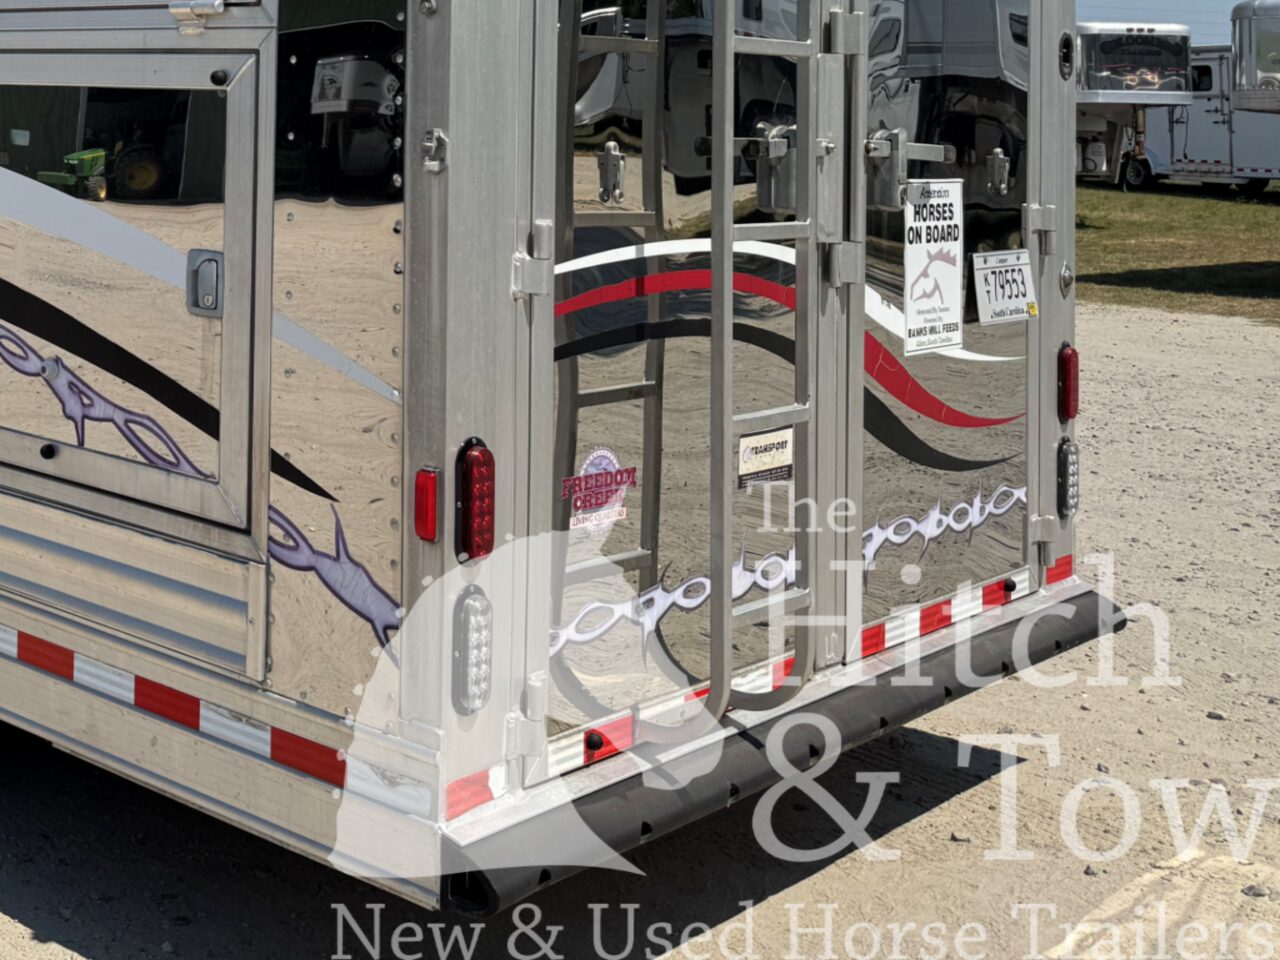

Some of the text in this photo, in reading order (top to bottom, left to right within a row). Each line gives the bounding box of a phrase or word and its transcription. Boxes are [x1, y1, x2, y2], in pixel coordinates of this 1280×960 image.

[913, 203, 954, 223] HORSES
[907, 224, 960, 245] ON BOARD
[991, 268, 1027, 302] 79553
[908, 322, 959, 338] BANKS MILL FEEDS
[751, 439, 788, 456] TRANSPORT
[561, 466, 637, 500] FREEDOM
[572, 514, 593, 528] LIVING
